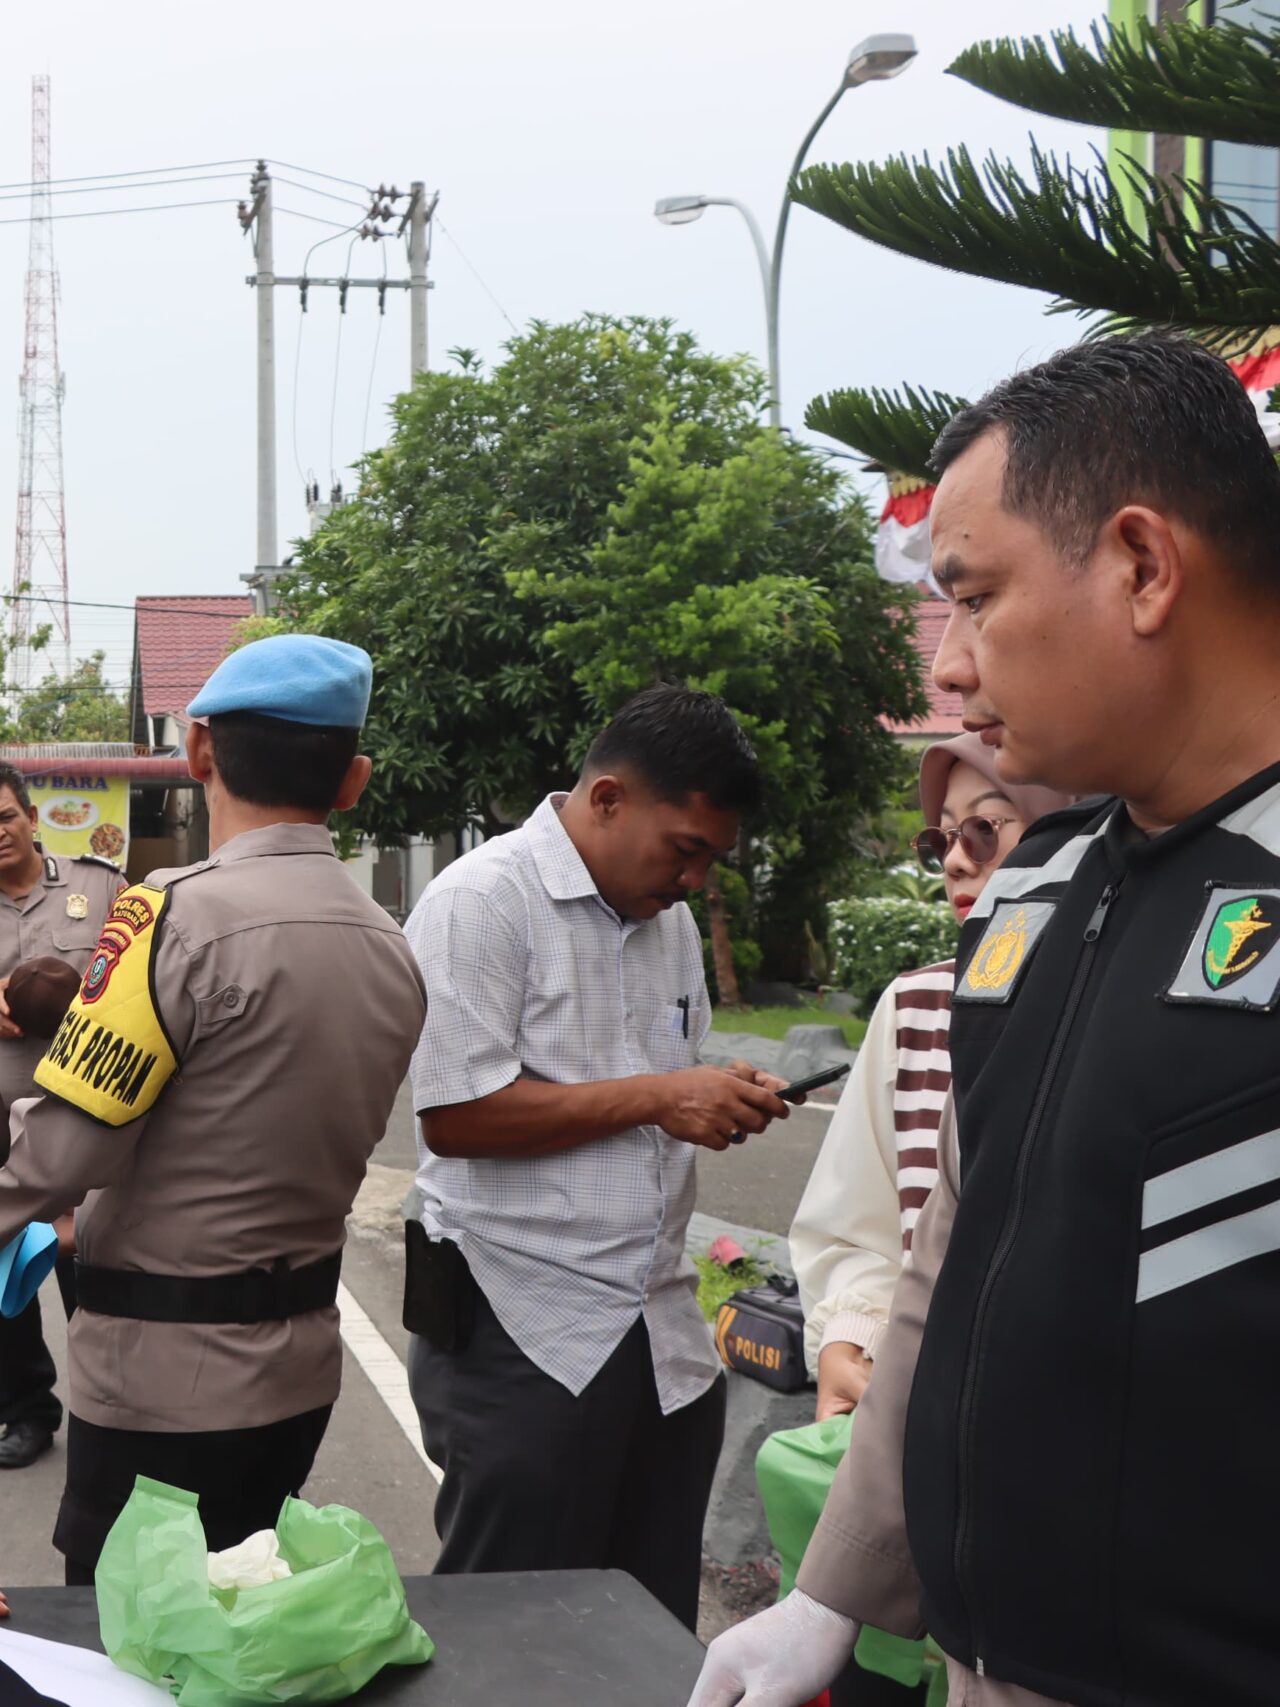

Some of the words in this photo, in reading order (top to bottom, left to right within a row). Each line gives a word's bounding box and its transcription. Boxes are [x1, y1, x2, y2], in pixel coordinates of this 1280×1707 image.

[51, 775, 110, 791] BARA
[113, 899, 150, 923] POLRES
[735, 1336, 781, 1371] POLISI
